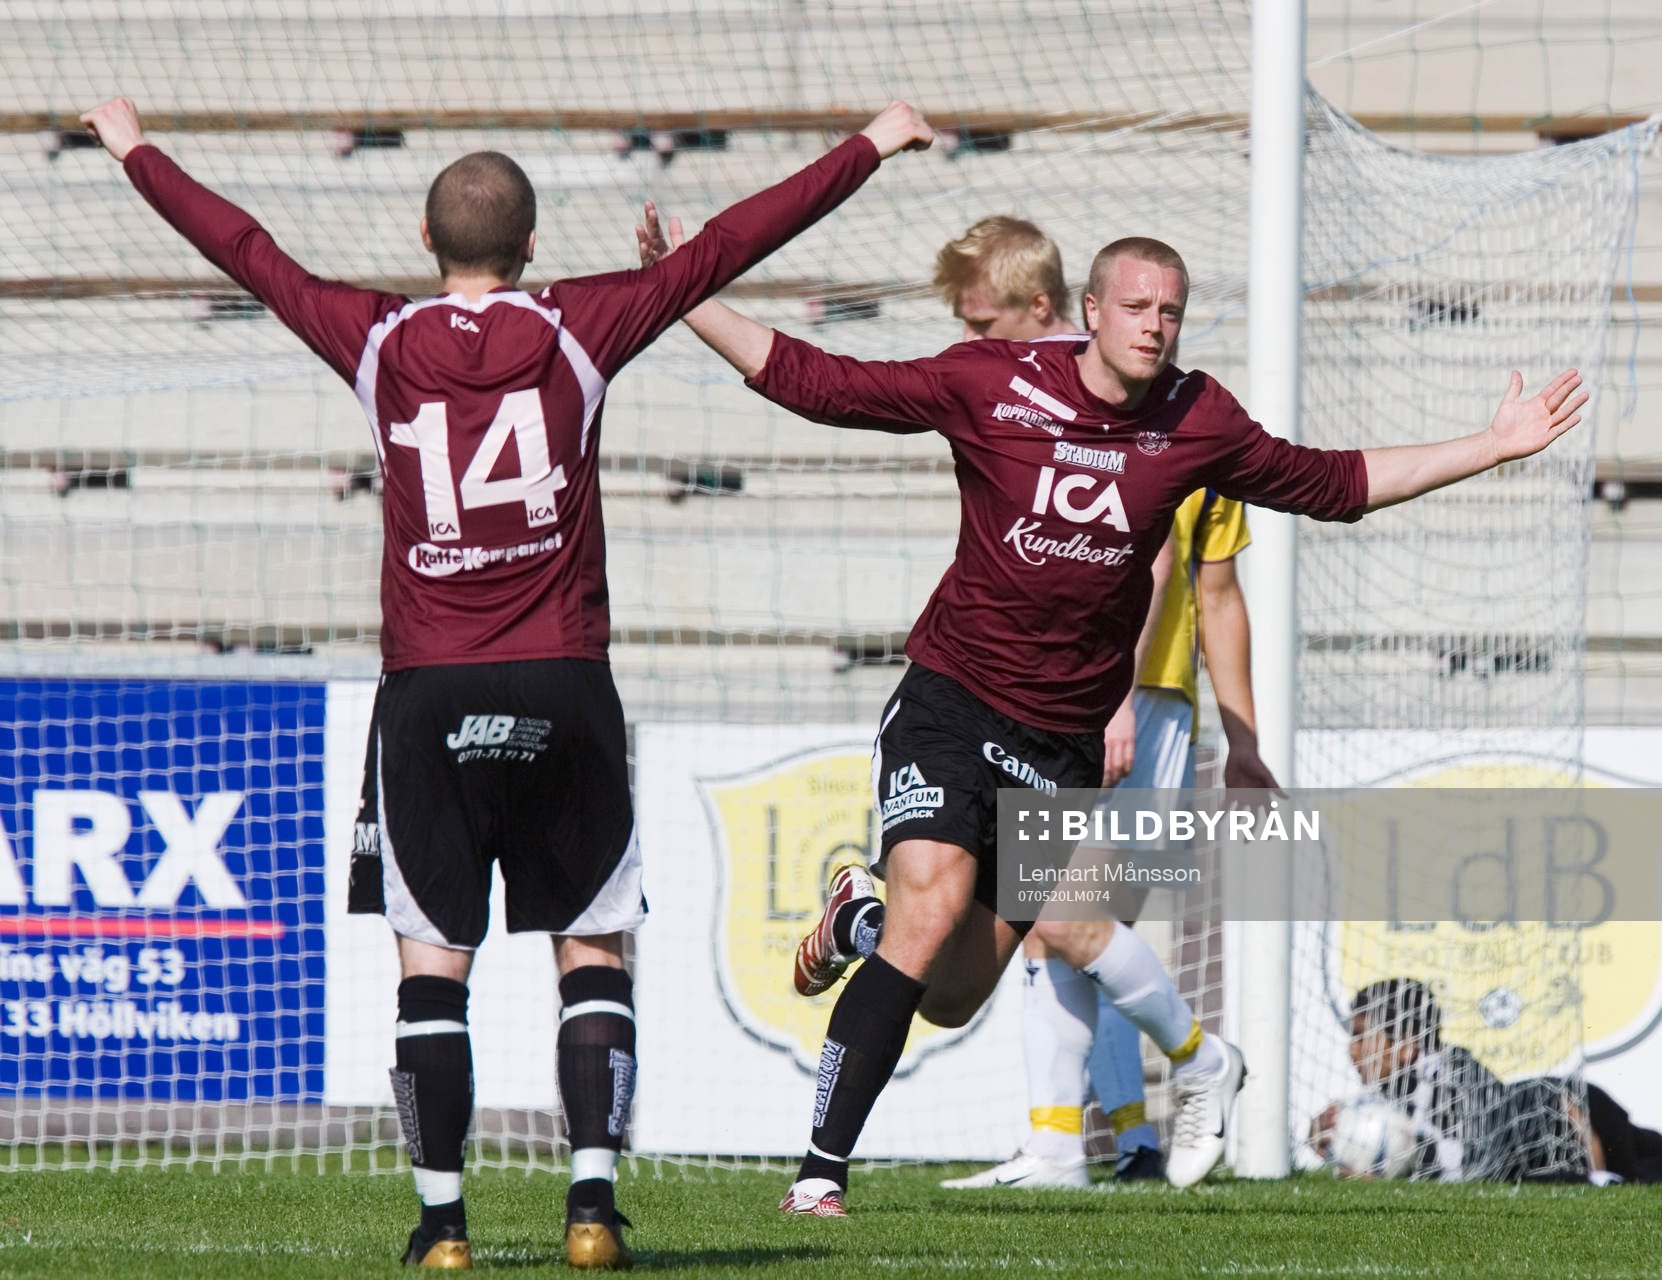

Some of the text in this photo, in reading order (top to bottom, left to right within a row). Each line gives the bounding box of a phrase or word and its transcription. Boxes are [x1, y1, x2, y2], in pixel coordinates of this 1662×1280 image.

[450, 313, 480, 333] ICA
[992, 402, 1065, 437] KOPPARBERG
[389, 387, 568, 542] 14
[1053, 441, 1127, 474] STADIUM
[529, 505, 555, 522] ICA
[1031, 466, 1131, 533] ICA
[431, 523, 457, 536] ICA
[1002, 517, 1134, 566] Kundkort
[446, 715, 516, 750] JAB
[889, 761, 927, 798] ICA
[982, 741, 1058, 798] Canon
[883, 791, 939, 815] VANTUM
[0, 789, 247, 909] RX
[1386, 815, 1615, 933] LdB
[58, 945, 130, 993] väg
[137, 948, 185, 985] 53
[2, 1001, 240, 1041] 33 Höllviken
